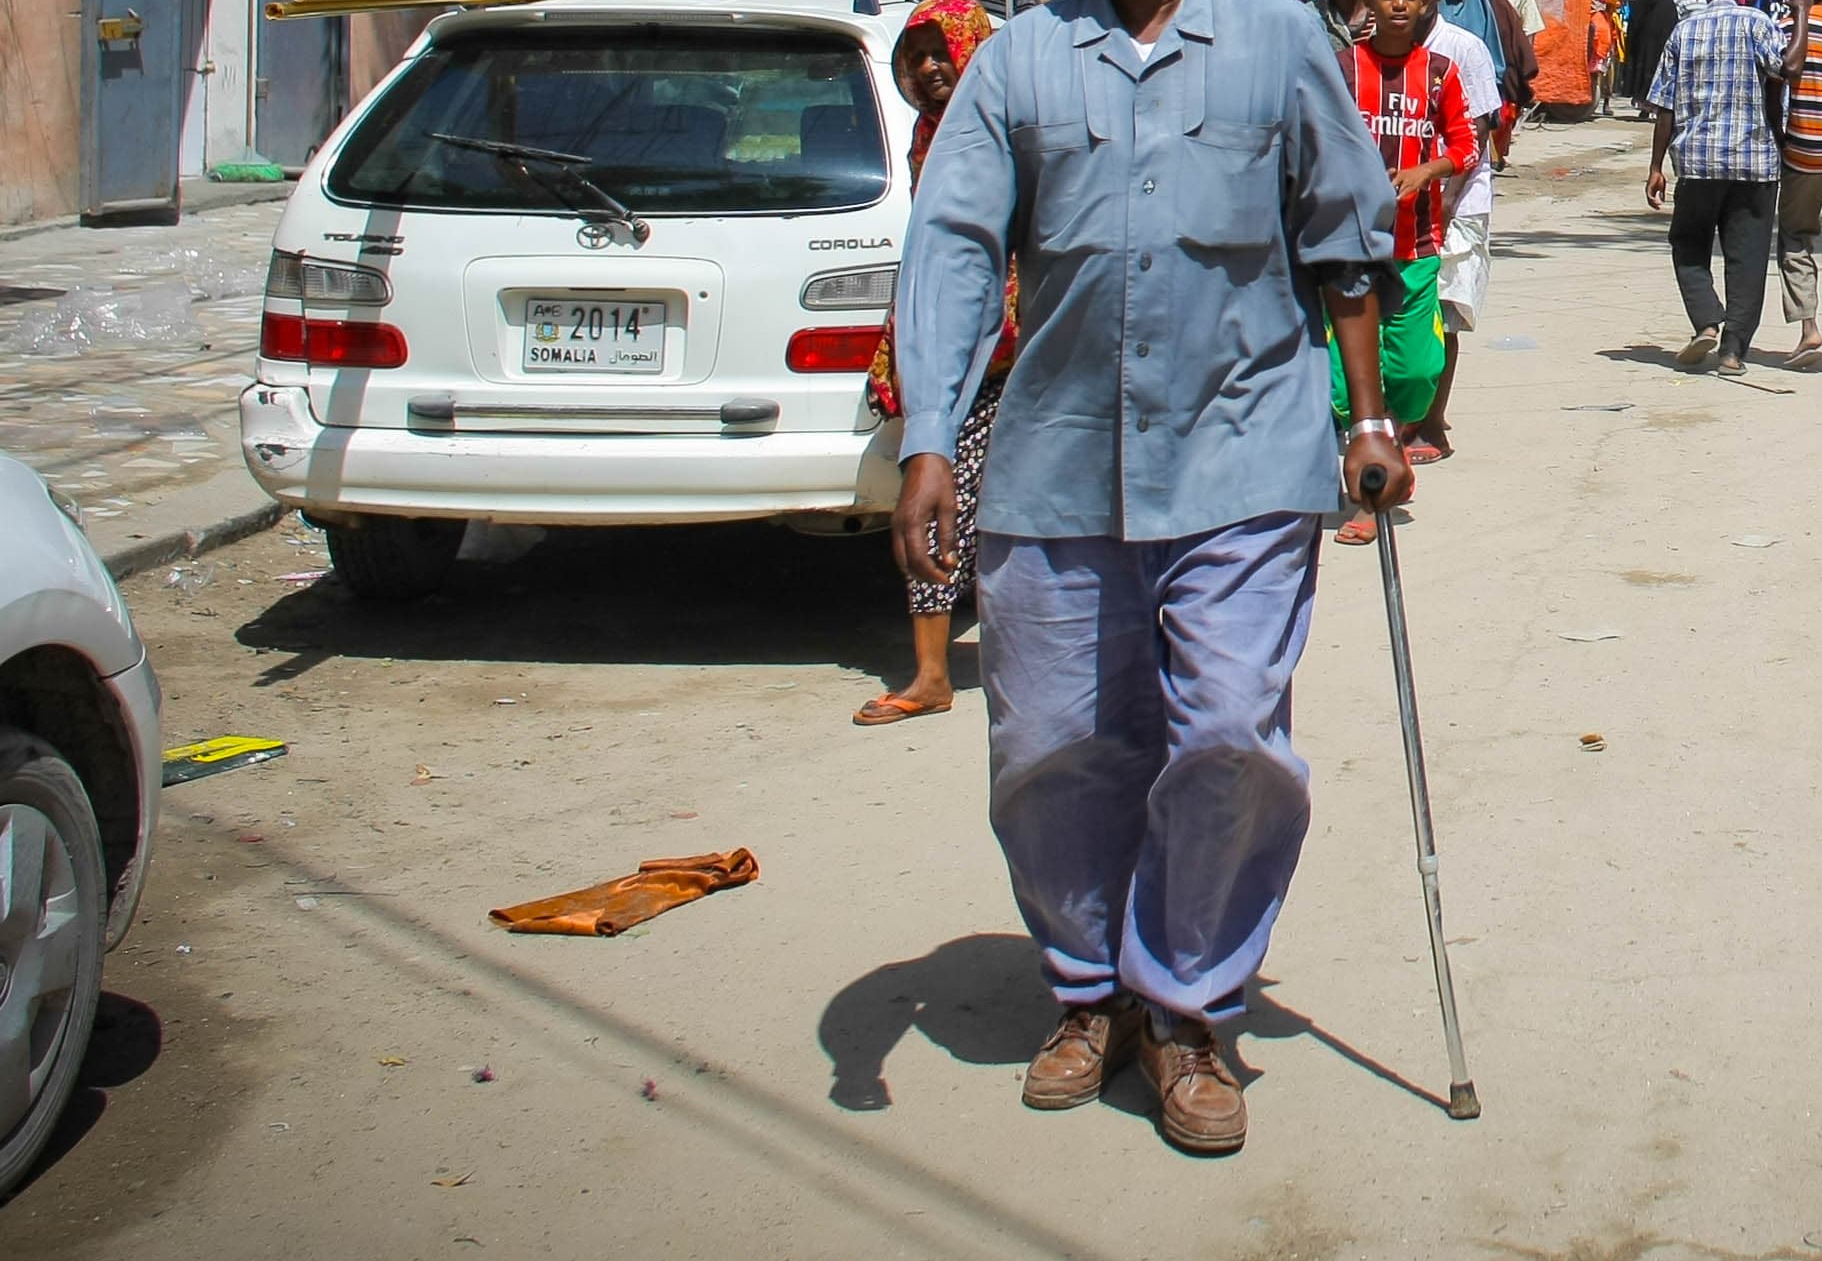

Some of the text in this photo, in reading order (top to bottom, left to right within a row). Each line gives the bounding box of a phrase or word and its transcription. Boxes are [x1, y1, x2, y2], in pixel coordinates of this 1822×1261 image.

[1389, 92, 1418, 115] Fly
[808, 238, 893, 251] COROLLA
[569, 305, 641, 341] 2014
[530, 347, 597, 363] SOMALIA
[609, 348, 657, 365] الصومال
